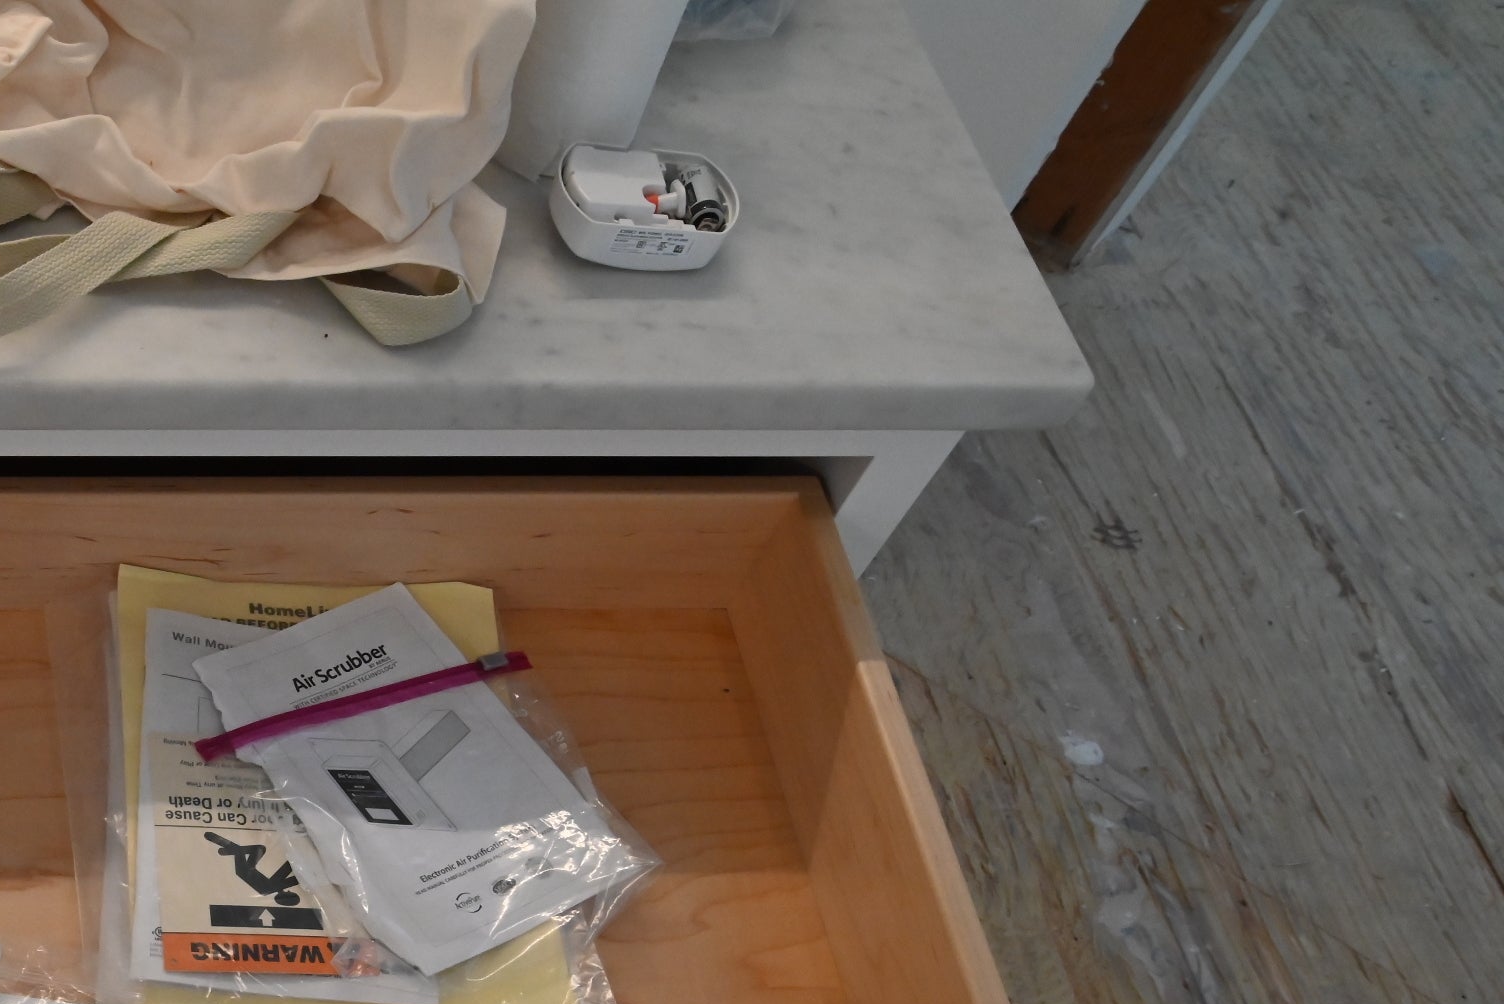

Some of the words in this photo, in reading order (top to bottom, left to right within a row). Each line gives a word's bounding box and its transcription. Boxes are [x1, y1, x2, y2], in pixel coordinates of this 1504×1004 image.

[172, 631, 201, 646] Wall
[292, 674, 315, 693] Air
[313, 644, 389, 684] Scrubber
[308, 688, 340, 705] CERTIFIED
[337, 678, 358, 694] SPACE
[356, 660, 396, 685] TECHNOLOGY
[168, 795, 213, 810] Death
[216, 798, 232, 808] or
[165, 809, 213, 824] Cause
[217, 813, 248, 826] Can
[419, 862, 457, 884] Electronic
[455, 857, 467, 869] Air
[190, 942, 326, 965] WARNING
